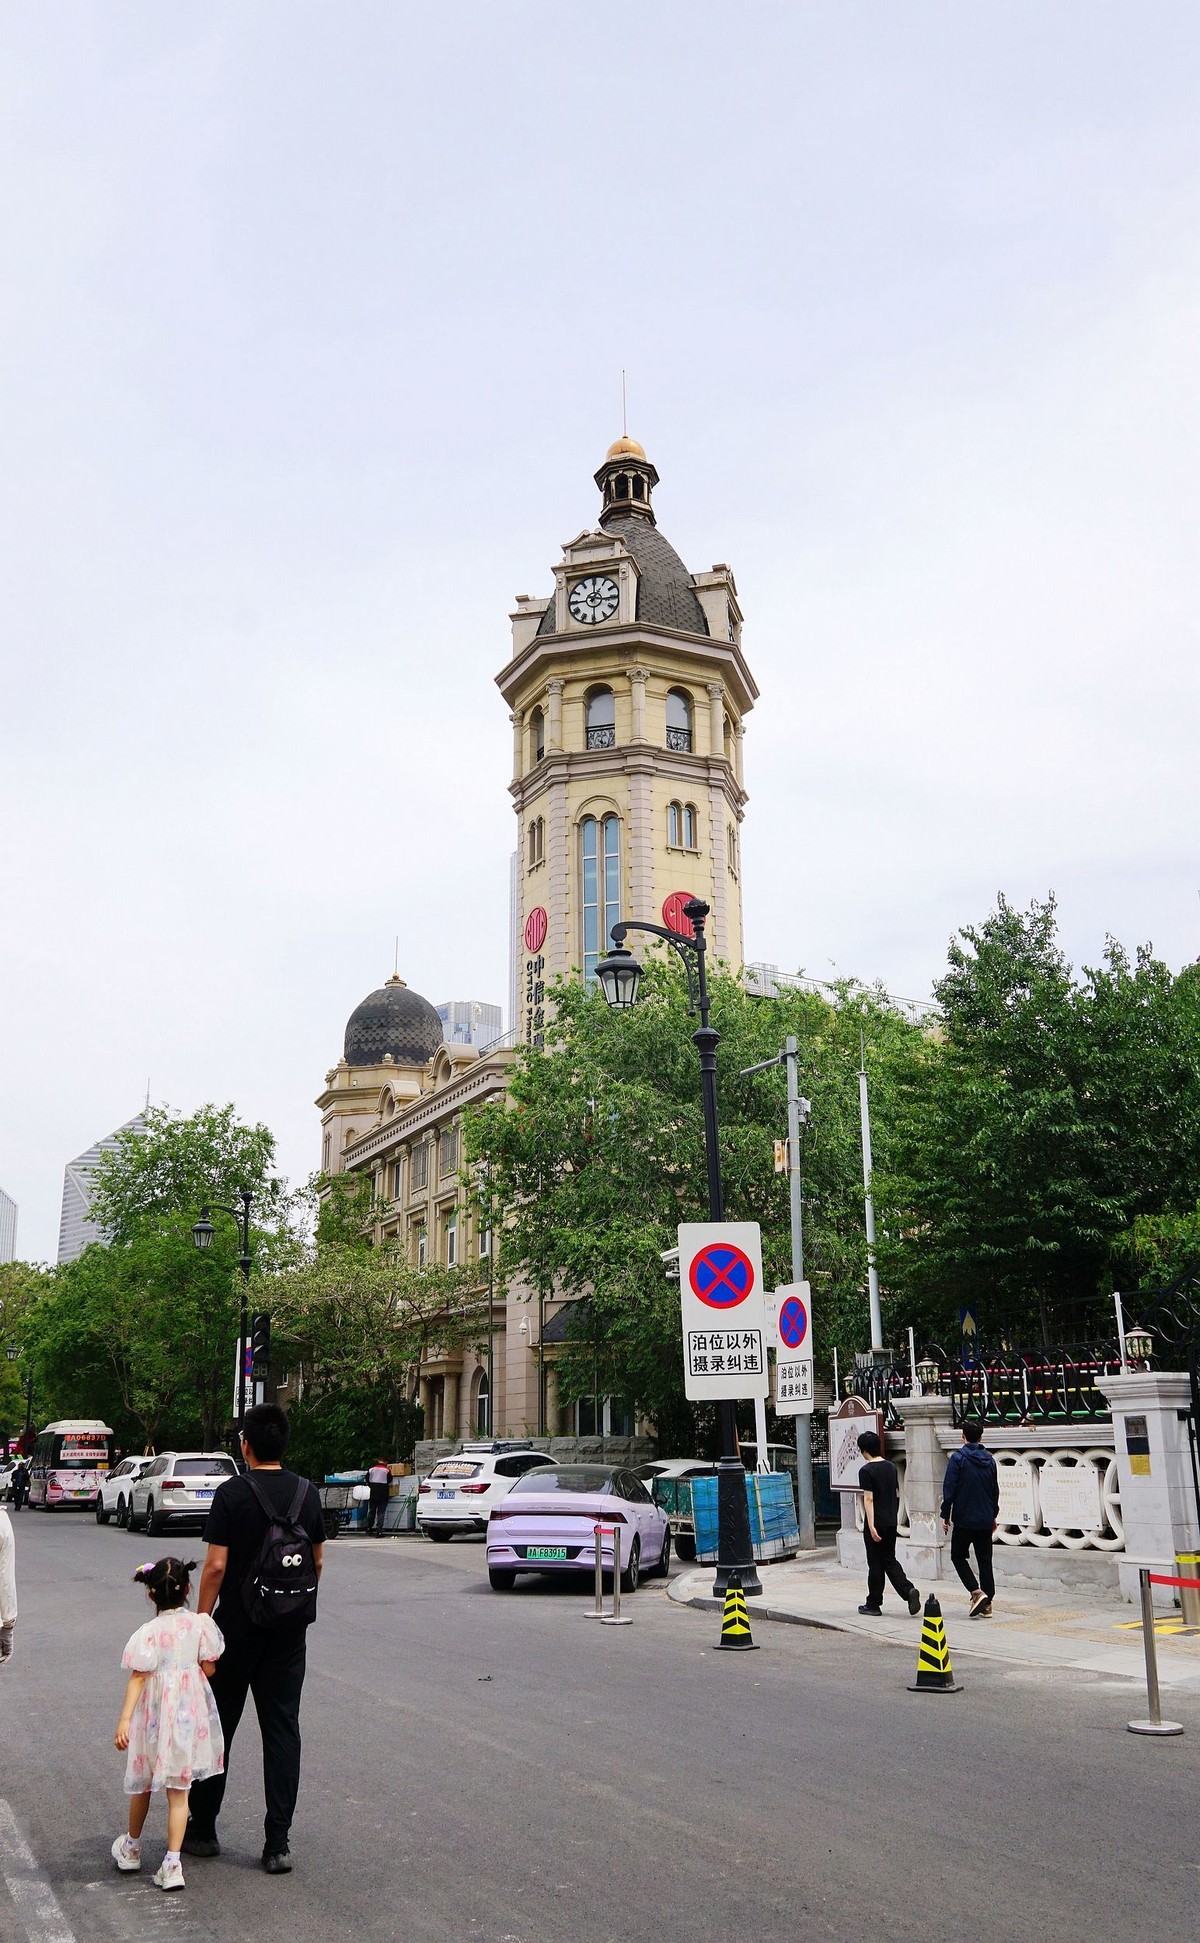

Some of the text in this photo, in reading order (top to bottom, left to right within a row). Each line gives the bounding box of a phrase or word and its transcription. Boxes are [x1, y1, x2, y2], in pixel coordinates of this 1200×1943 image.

[692, 1333, 758, 1351] 泊位以外
[693, 1354, 760, 1372] 摄录纠违
[781, 1364, 808, 1379] 泊位以外
[781, 1383, 808, 1398] 摄录纠违
